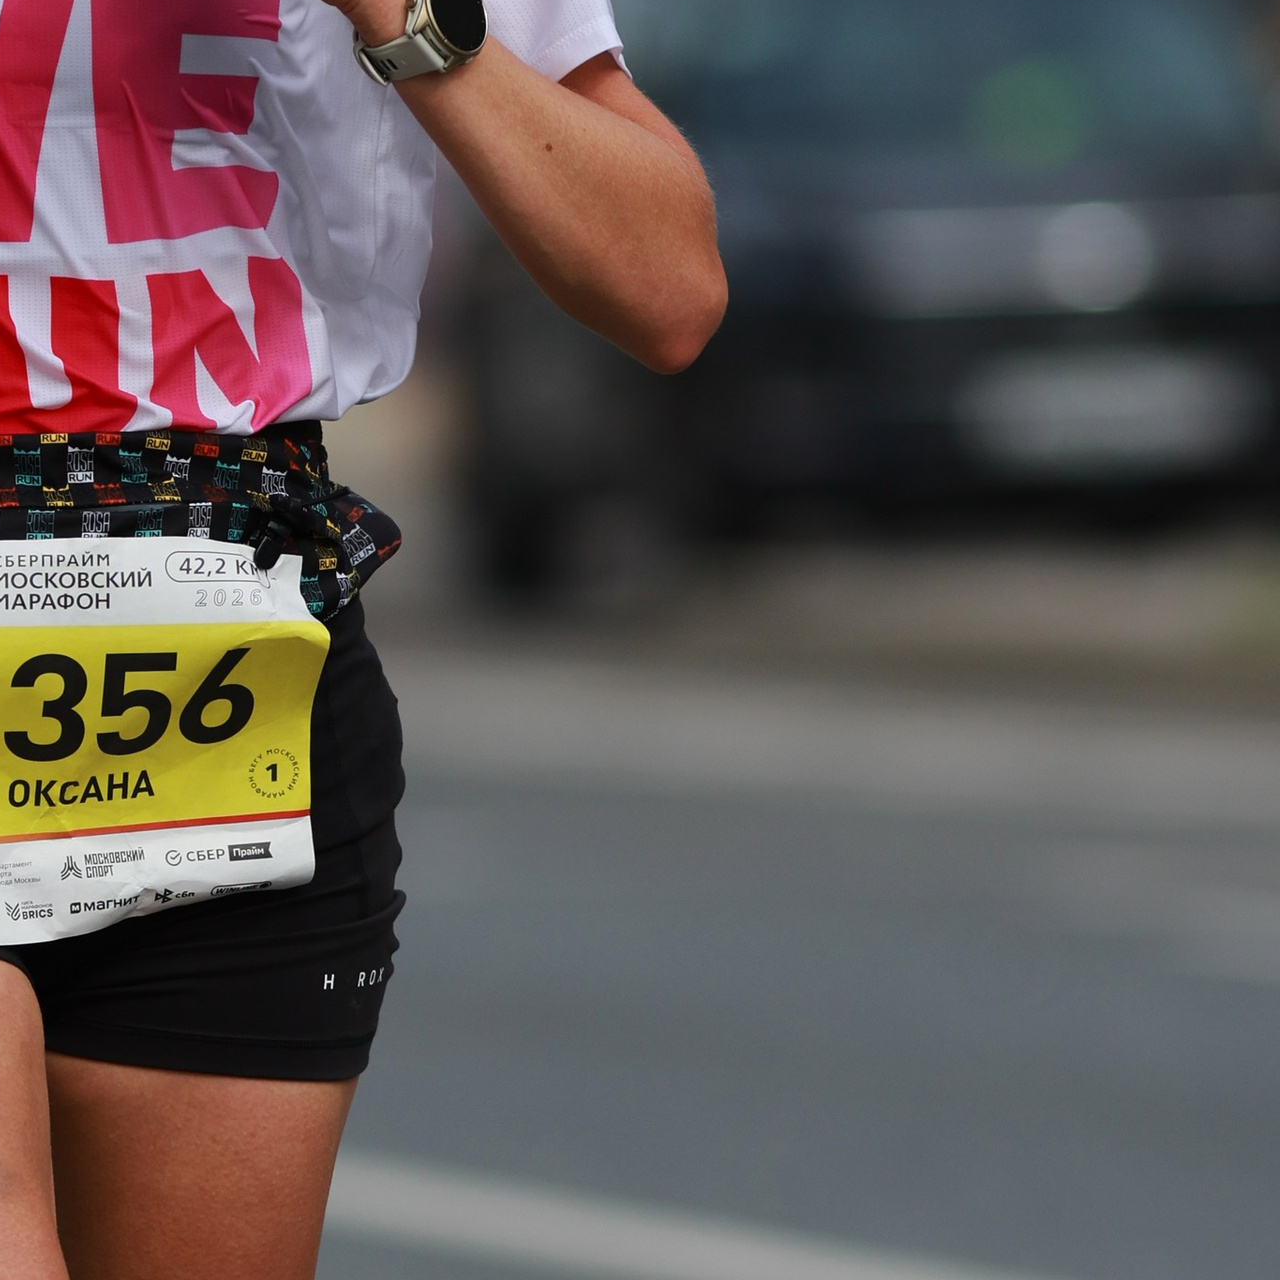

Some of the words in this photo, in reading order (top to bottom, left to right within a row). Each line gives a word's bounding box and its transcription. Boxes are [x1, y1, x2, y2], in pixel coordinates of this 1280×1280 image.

[41, 433, 67, 443] RUN
[96, 434, 121, 445] RUN
[146, 438, 169, 449] RUN
[195, 445, 218, 456] RUN
[243, 450, 266, 462] RUN
[67, 451, 95, 472] ROSA
[16, 475, 41, 486] RUN
[68, 472, 93, 482] RUN
[261, 473, 286, 495] ROSA
[82, 511, 111, 532] ROSA
[189, 506, 212, 527] ROSA
[189, 528, 209, 537] RUN
[343, 528, 373, 558] ROSA
[351, 545, 375, 565] RUN
[179, 557, 226, 577] 42,2
[320, 559, 337, 569] RUN
[195, 588, 262, 607] 2026
[265, 763, 277, 782] 1
[7, 769, 155, 808] ОКСАНА
[84, 847, 145, 866] МОСКОВСКИЙ
[186, 848, 225, 862] СБЕР
[233, 847, 265, 858] Прайм
[86, 865, 114, 879] СПОРТ
[22, 909, 53, 920] BRICS
